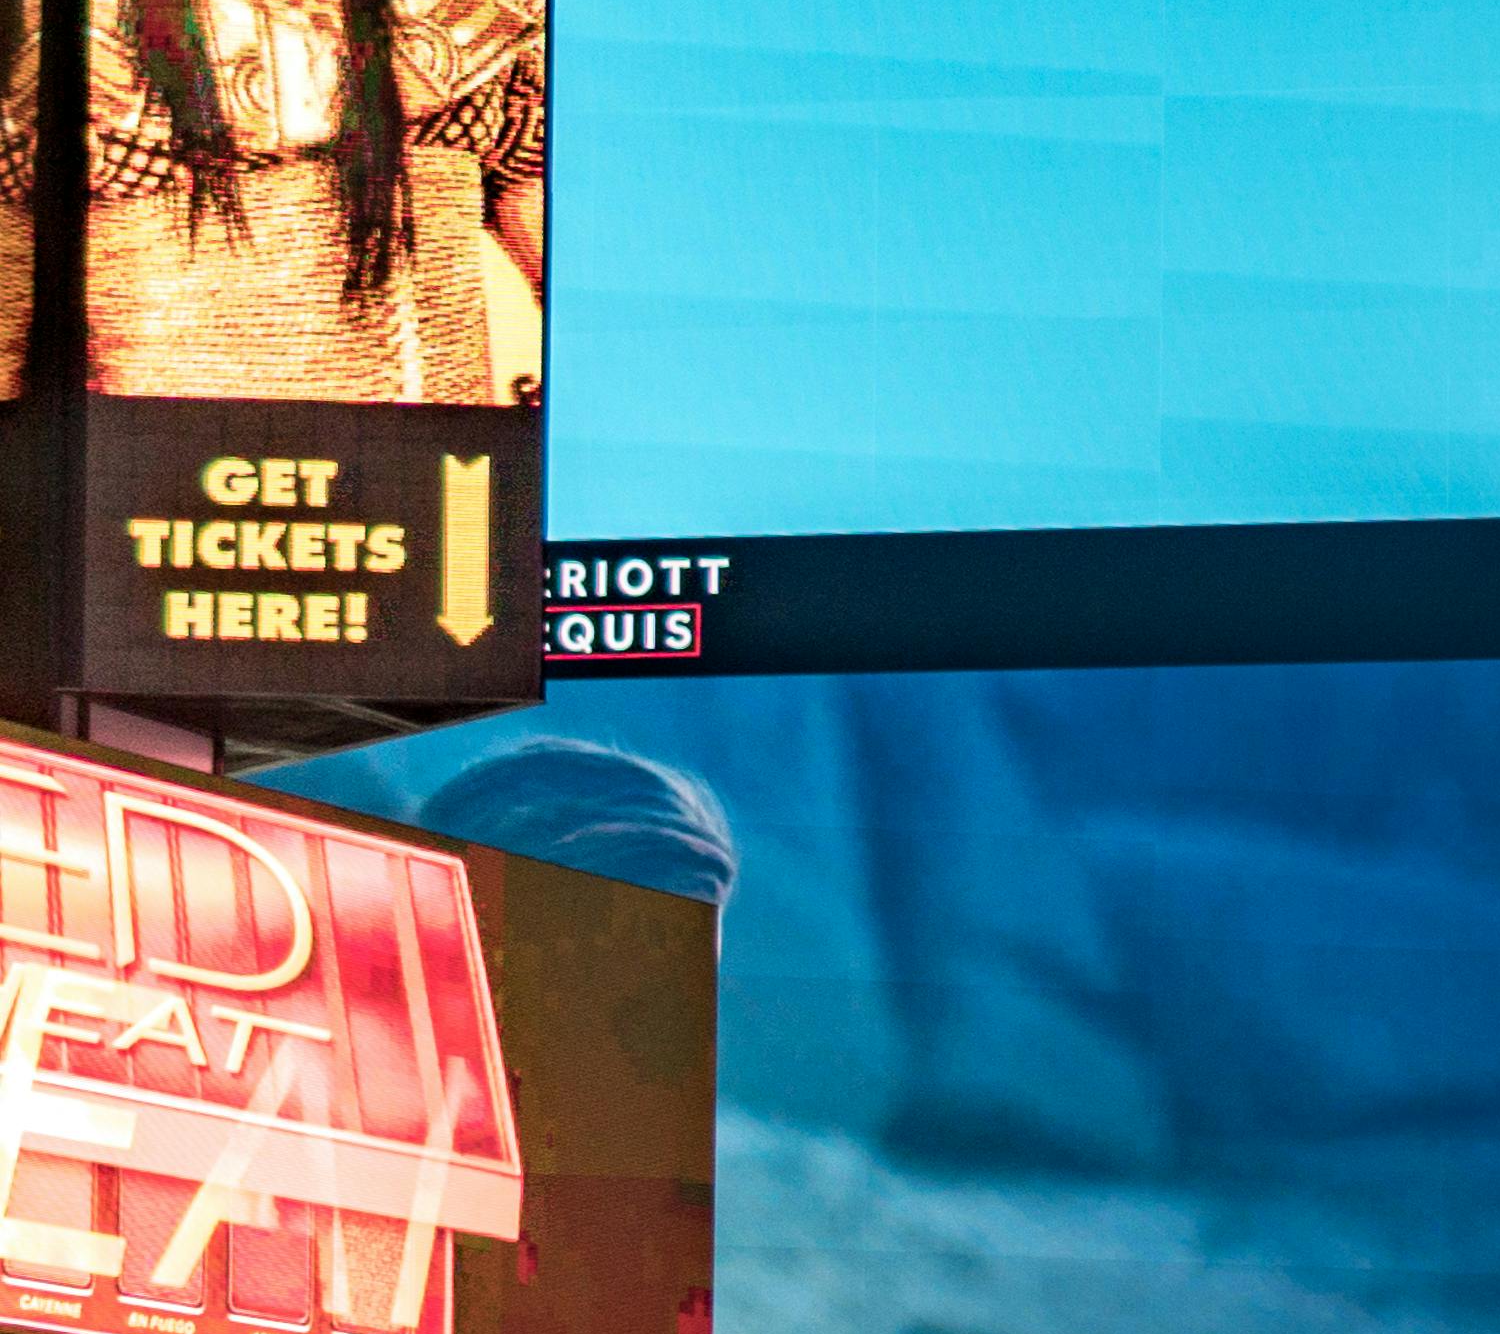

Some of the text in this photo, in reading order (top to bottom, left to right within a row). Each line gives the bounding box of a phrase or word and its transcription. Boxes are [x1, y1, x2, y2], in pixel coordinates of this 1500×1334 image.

[203, 458, 339, 507] GET
[128, 520, 406, 573] TICKETS
[164, 591, 369, 643] HERE!
[19, 1294, 83, 1319] CAYENNE
